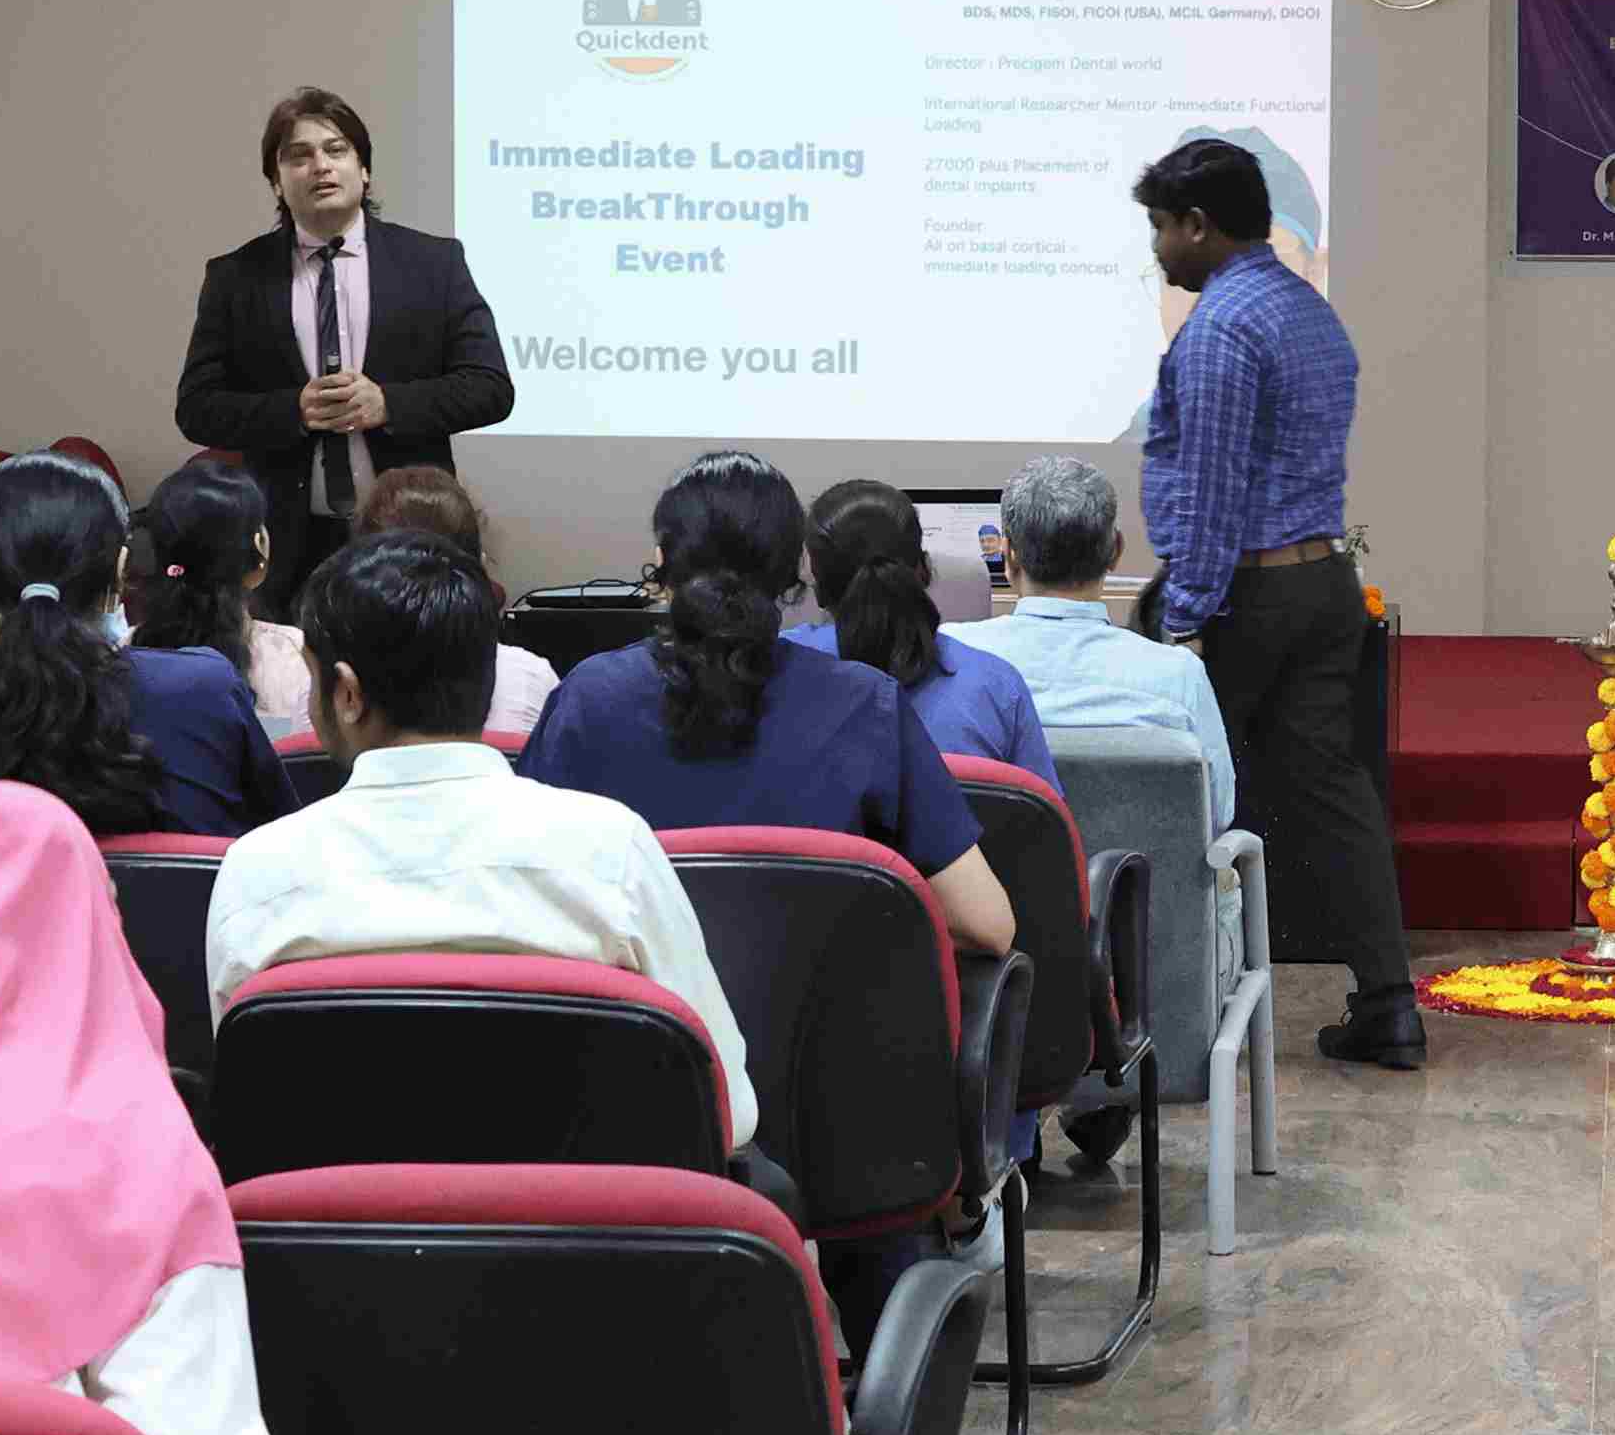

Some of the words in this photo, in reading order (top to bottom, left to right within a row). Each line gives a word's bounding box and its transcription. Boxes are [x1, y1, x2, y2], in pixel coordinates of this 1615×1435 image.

[576, 29, 709, 53] Quickdent
[489, 139, 696, 169] Immediate
[711, 141, 865, 178] Loading
[531, 191, 810, 229] BreakThrough
[1582, 231, 1600, 242] Dr.
[615, 244, 726, 273] Event
[512, 336, 707, 373] Welcome
[721, 346, 798, 380] you
[811, 339, 859, 374] all
